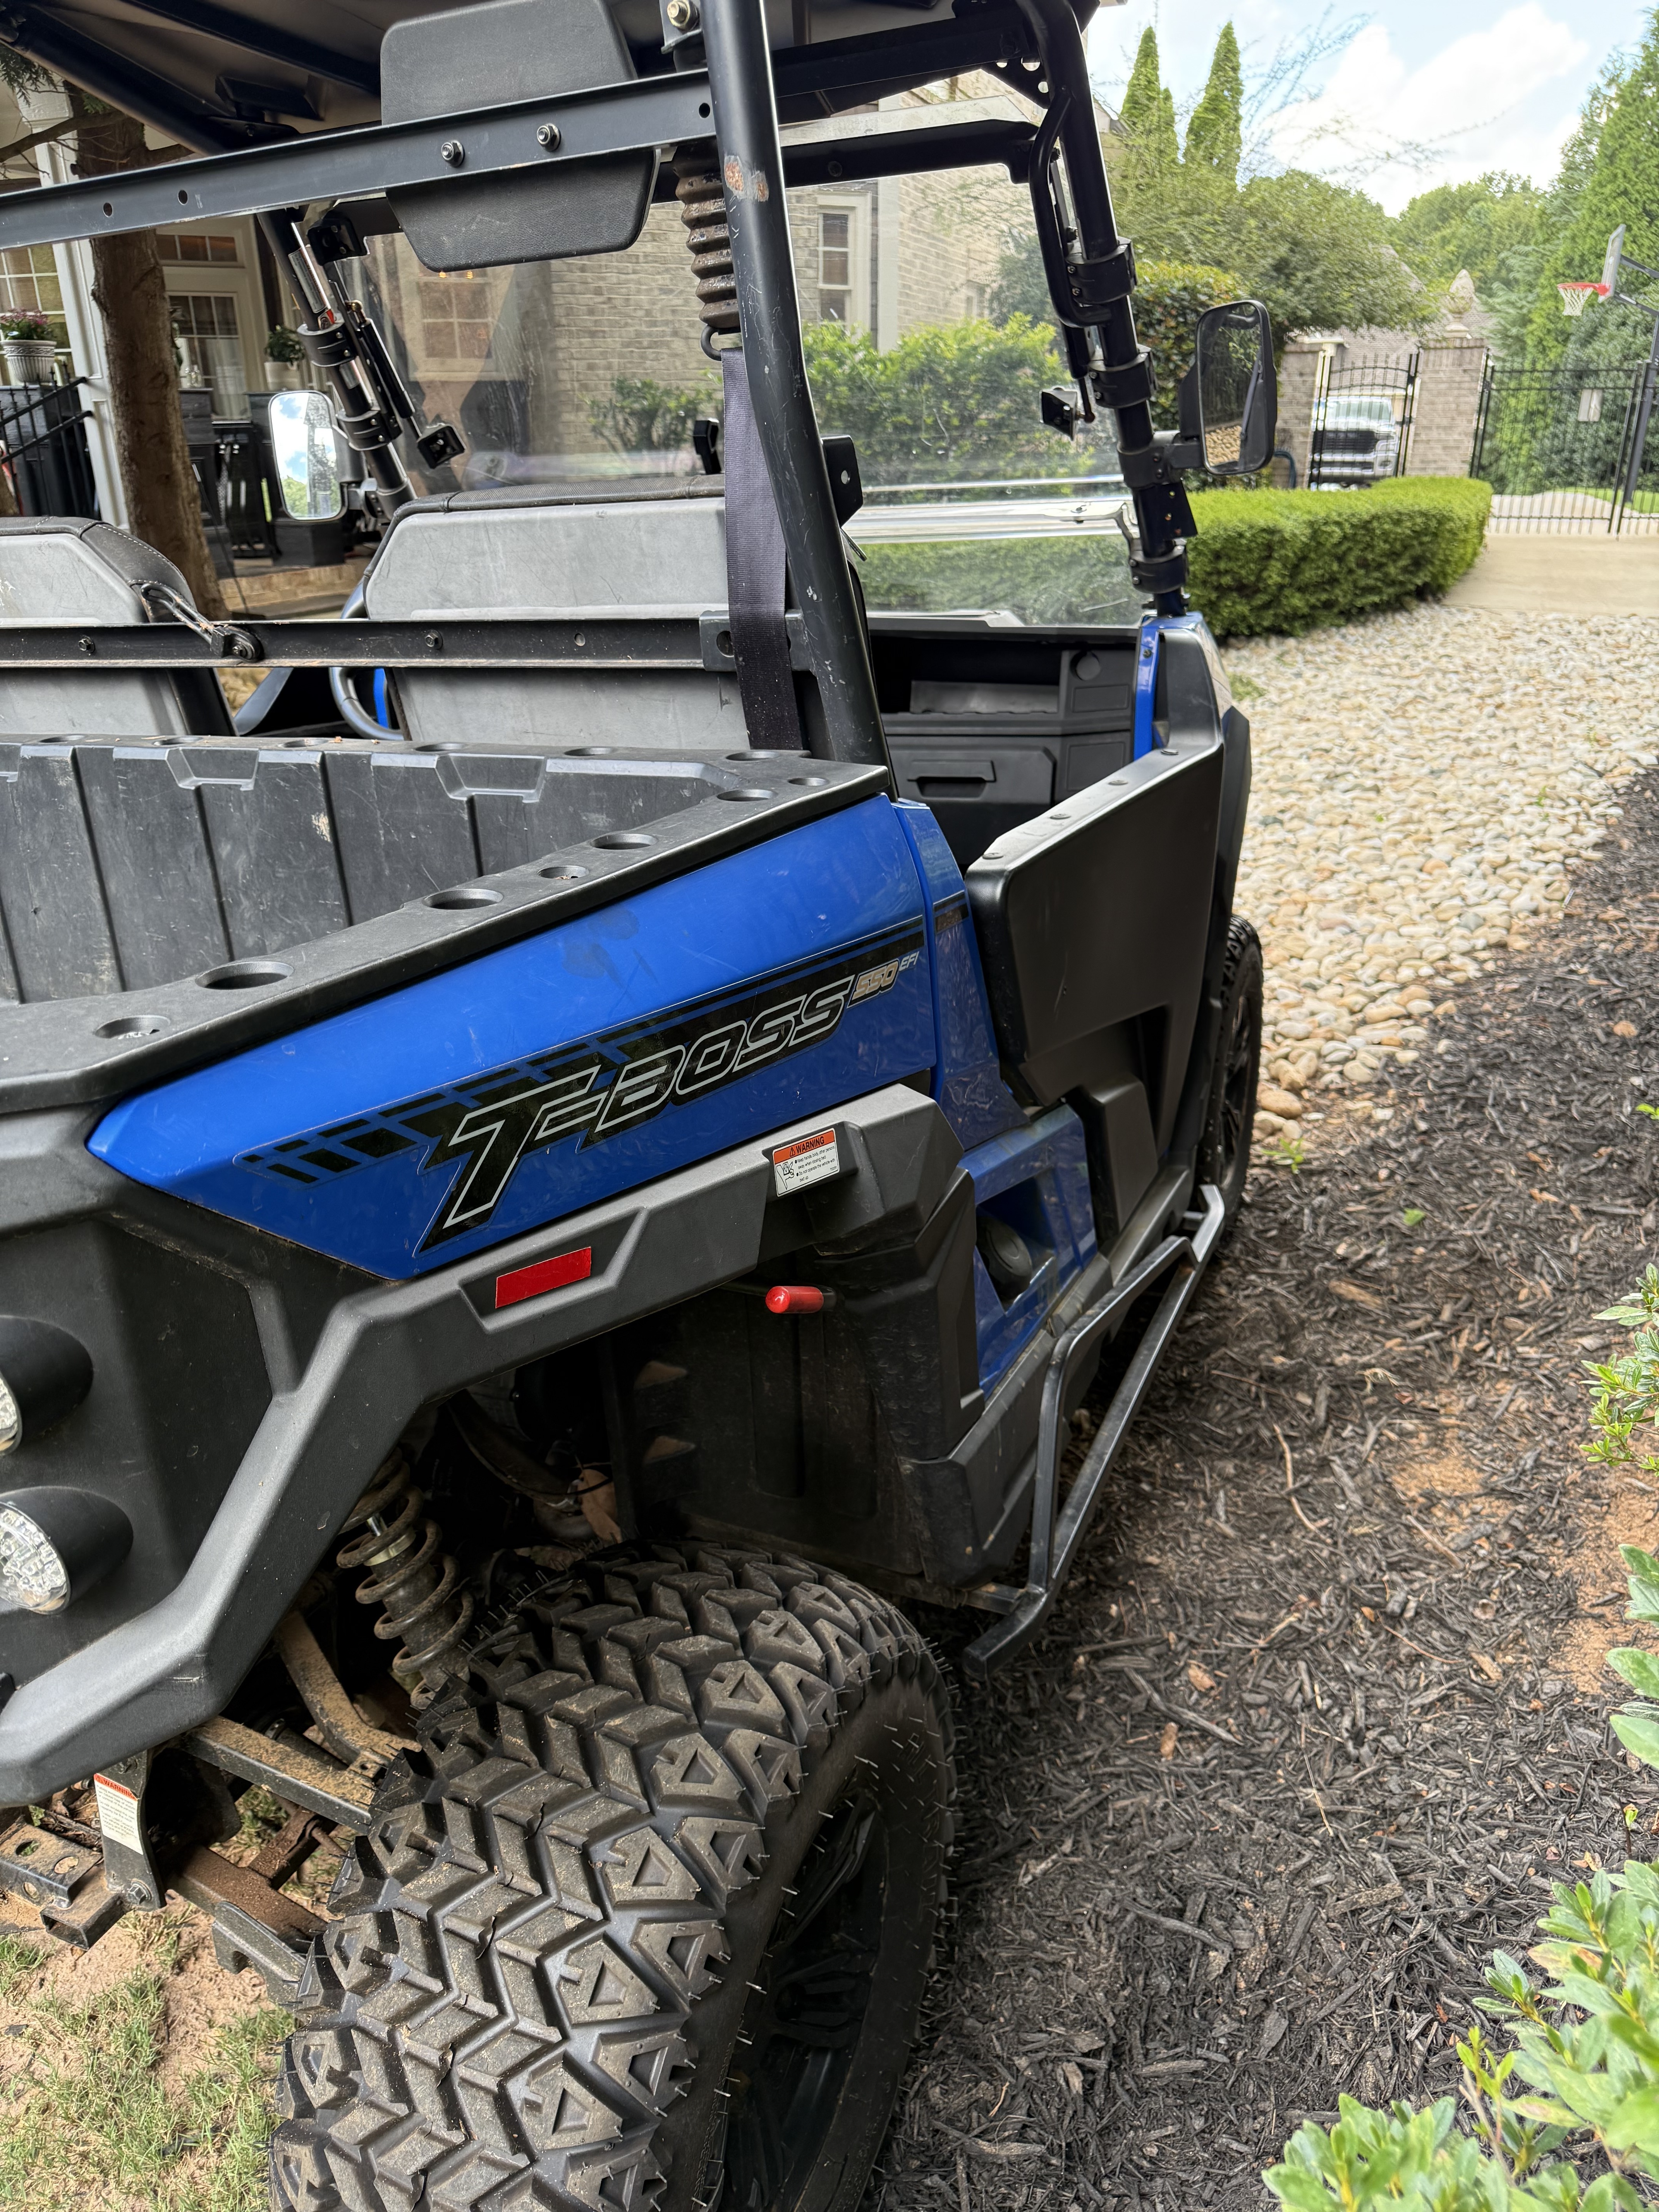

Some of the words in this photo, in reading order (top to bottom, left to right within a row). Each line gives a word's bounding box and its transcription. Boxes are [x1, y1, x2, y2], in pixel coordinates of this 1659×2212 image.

[443, 974, 855, 1229] T-BOSS
[851, 960, 899, 1001] 550
[898, 951, 919, 971] EFI
[796, 1136, 824, 1154] WARNING
[103, 1779, 135, 1800] WARNING
